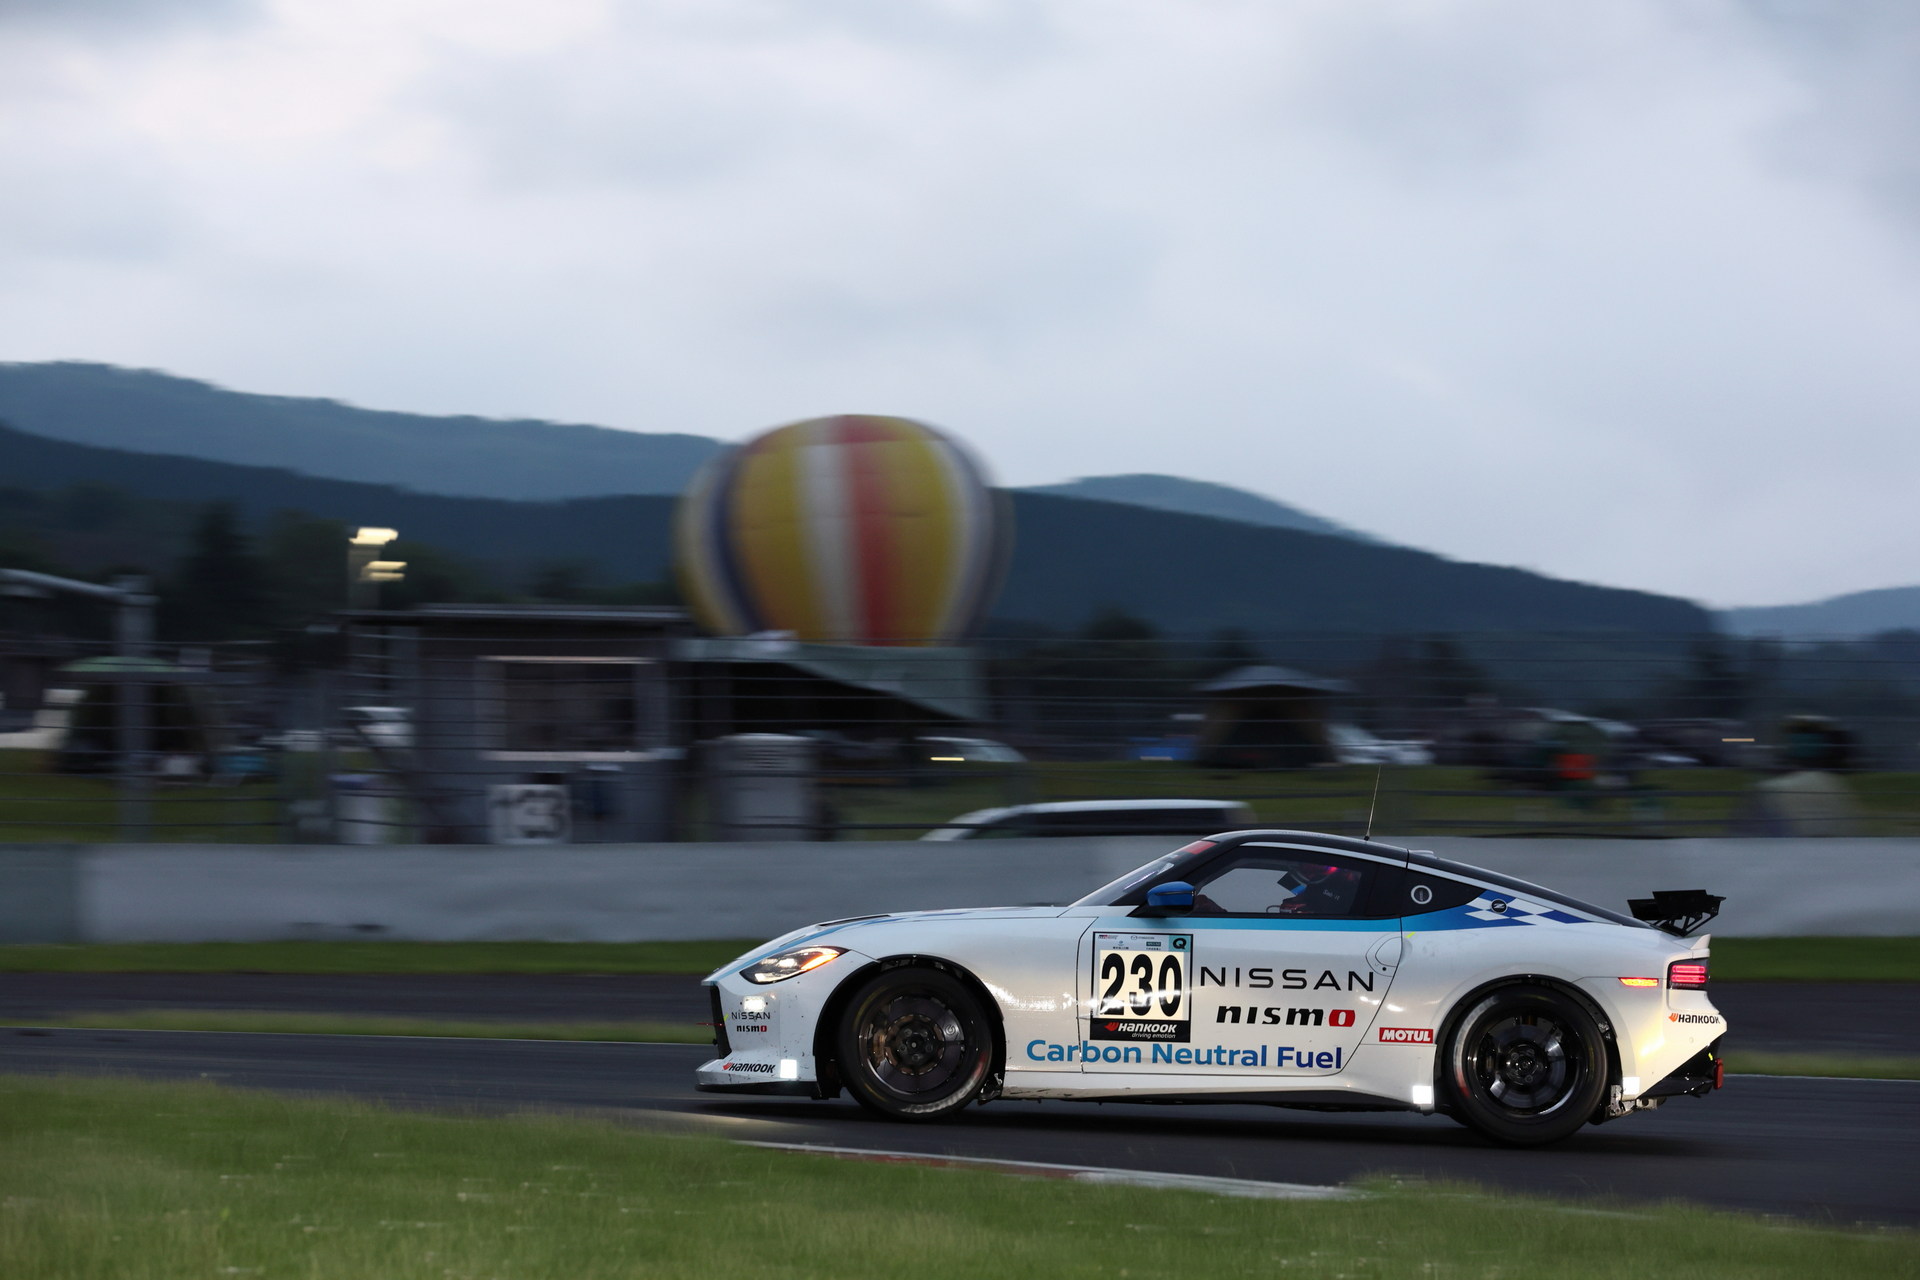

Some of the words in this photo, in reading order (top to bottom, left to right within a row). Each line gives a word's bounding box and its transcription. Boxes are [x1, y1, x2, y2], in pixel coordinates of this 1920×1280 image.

[1172, 938, 1187, 950] Q
[1100, 953, 1183, 1017] 230
[1200, 966, 1374, 992] NISSAN
[731, 1011, 771, 1021] NISSAN
[1216, 1006, 1356, 1027] nismo
[1131, 1032, 1152, 1040] driving
[1381, 1029, 1431, 1042] MOTUL
[1026, 1040, 1142, 1063] Carbon
[1151, 1043, 1268, 1067] Neutral
[1277, 1046, 1342, 1069] Fuel
